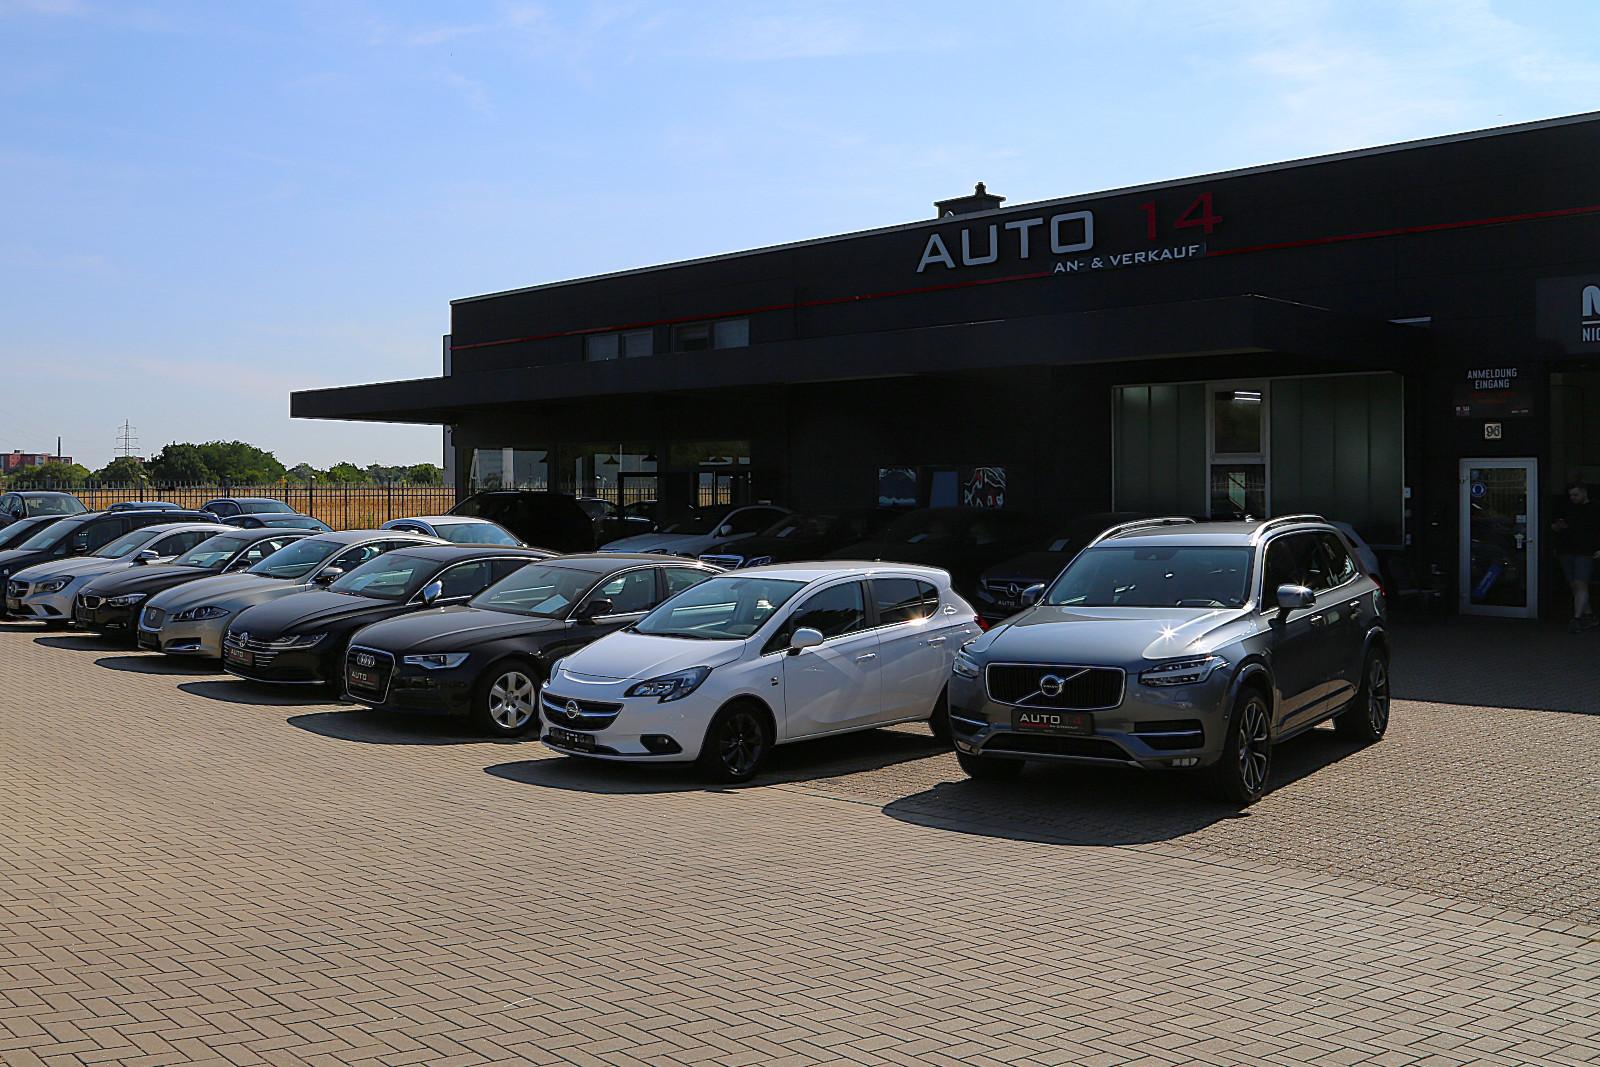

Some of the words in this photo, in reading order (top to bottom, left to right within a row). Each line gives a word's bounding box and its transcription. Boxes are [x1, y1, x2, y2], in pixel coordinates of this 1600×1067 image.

[916, 210, 1094, 273] AUTO
[1138, 192, 1224, 241] 14
[1054, 259, 1085, 274] AN-
[1091, 257, 1104, 269] &
[1109, 244, 1200, 267] VERKAUF
[1467, 368, 1518, 379] ANMELDUNG
[1475, 379, 1510, 389] EINGANG
[351, 671, 368, 681] AUTO
[1019, 713, 1061, 724] AUTO
